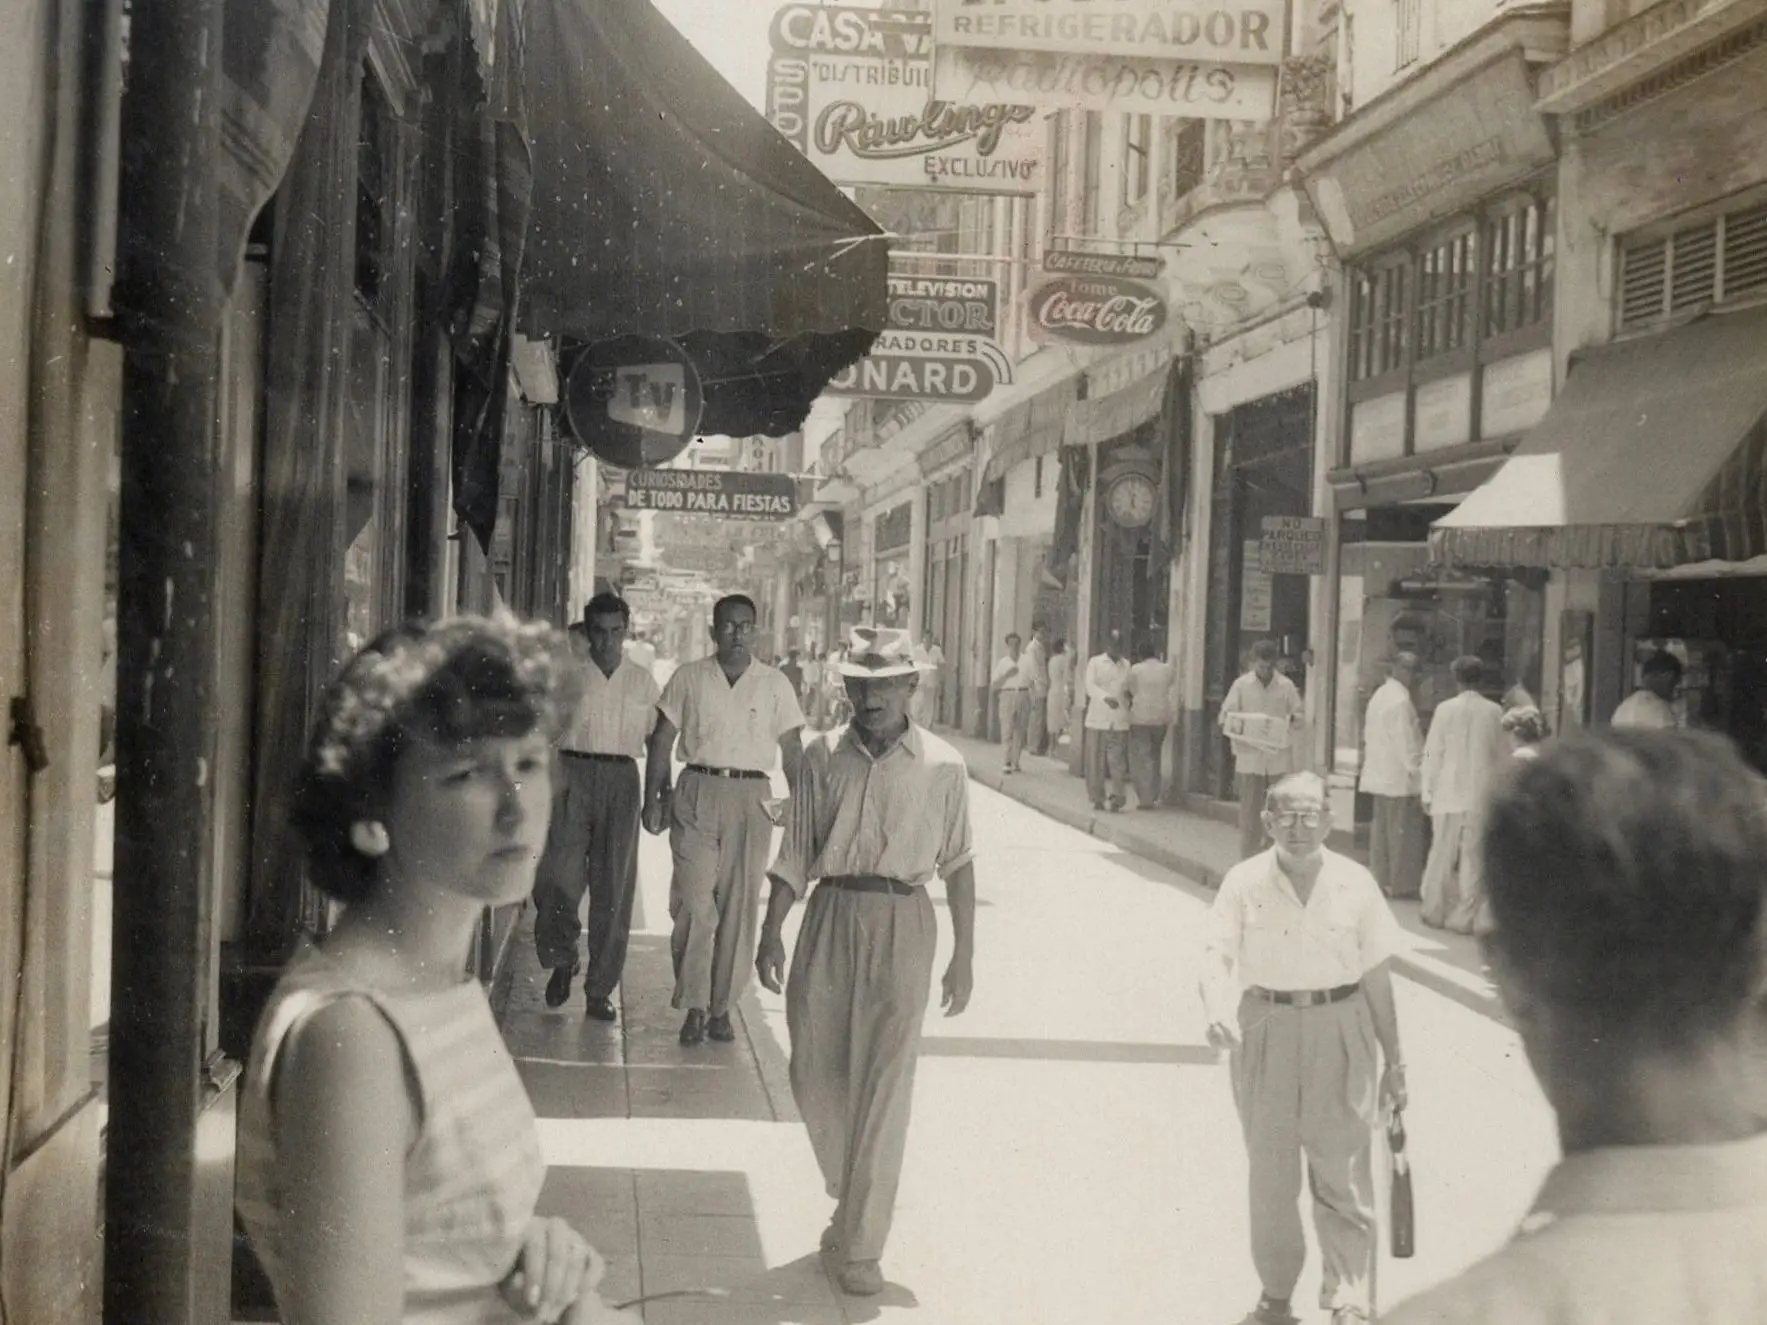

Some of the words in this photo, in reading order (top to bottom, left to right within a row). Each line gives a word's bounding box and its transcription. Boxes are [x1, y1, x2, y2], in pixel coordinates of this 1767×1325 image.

[953, 9, 1271, 51] REFRIGERADOR
[814, 99, 1036, 159] Rawlings
[887, 279, 988, 299] TELEVISION
[1070, 280, 1118, 296] Tome
[890, 298, 993, 331] CTOR
[1038, 291, 1158, 334] Coca-Cola
[623, 373, 677, 419] TV
[628, 489, 647, 507] DE
[650, 490, 684, 509] TODO
[687, 491, 730, 511] PARA
[732, 494, 792, 513] FIESTAS
